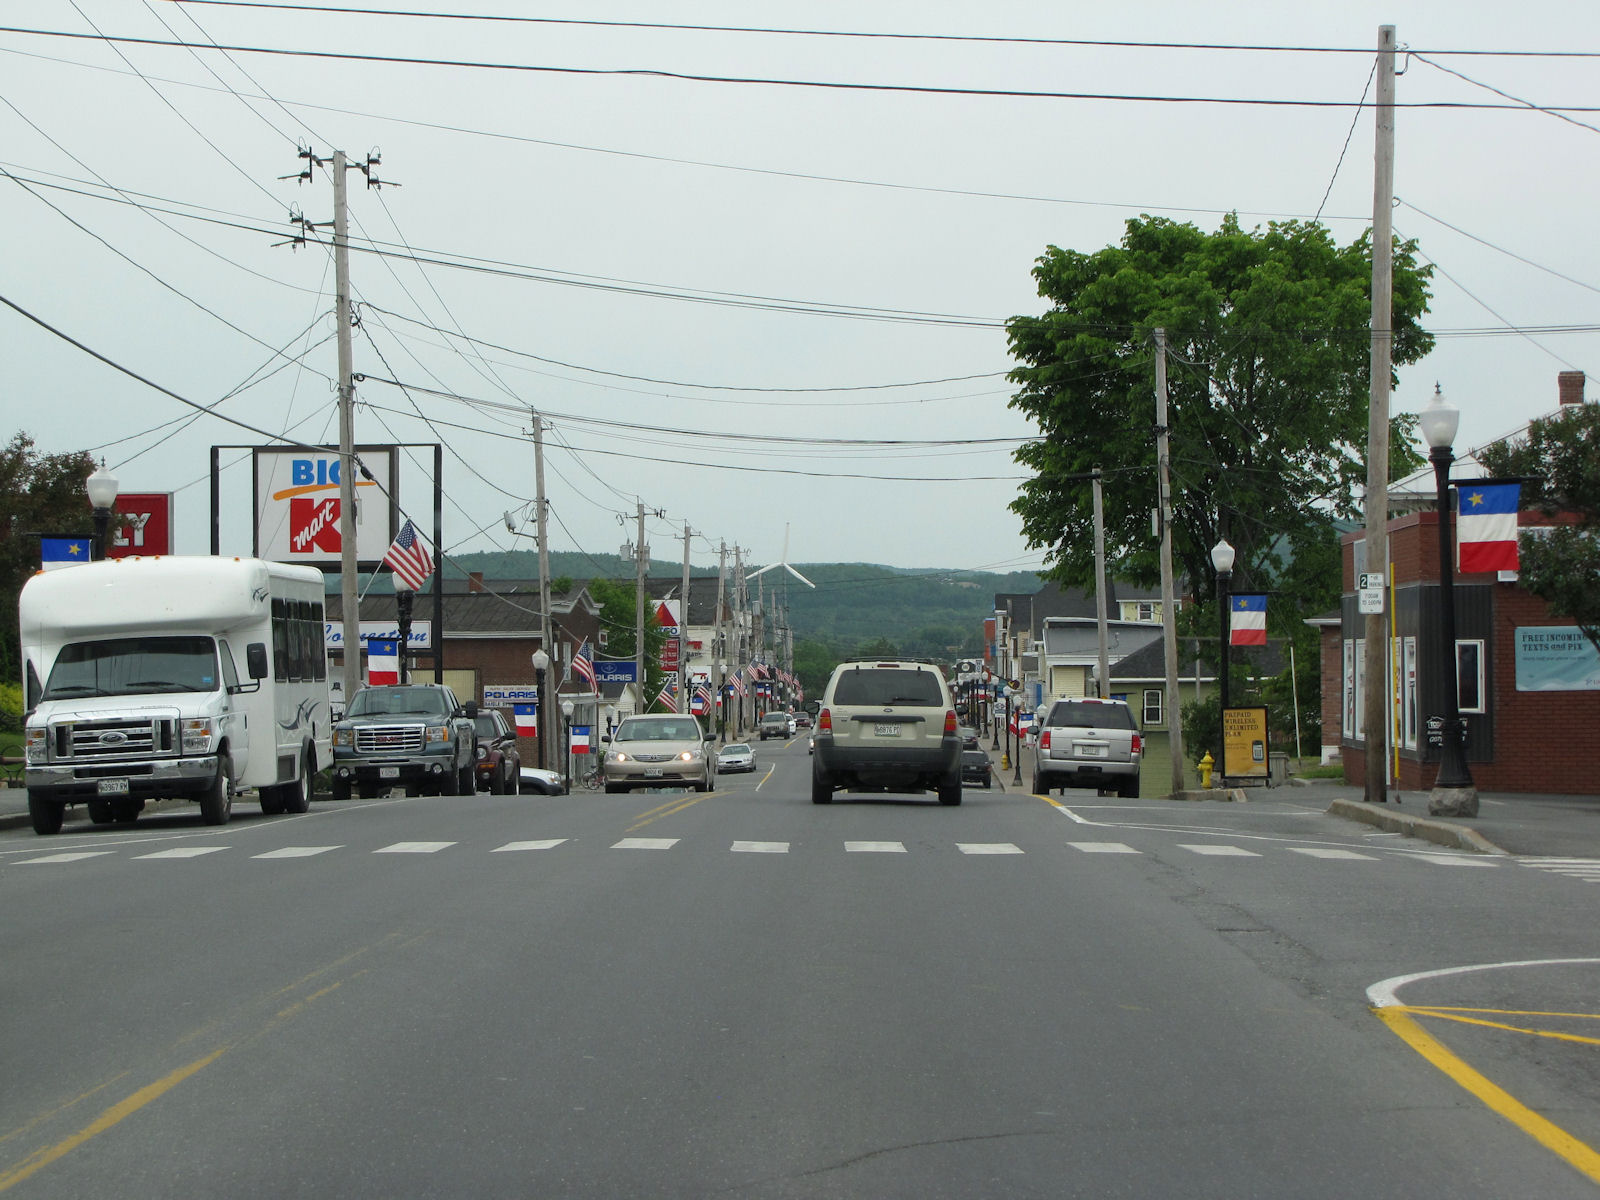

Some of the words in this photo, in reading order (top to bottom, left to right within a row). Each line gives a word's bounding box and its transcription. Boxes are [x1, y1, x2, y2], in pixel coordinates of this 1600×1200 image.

[293, 501, 335, 551] mart
[1522, 633, 1545, 642] FREE
[1522, 643, 1550, 652] TEXTS
[1550, 642, 1566, 650] and
[1567, 642, 1583, 651] PIX
[485, 691, 537, 699] POLARIS
